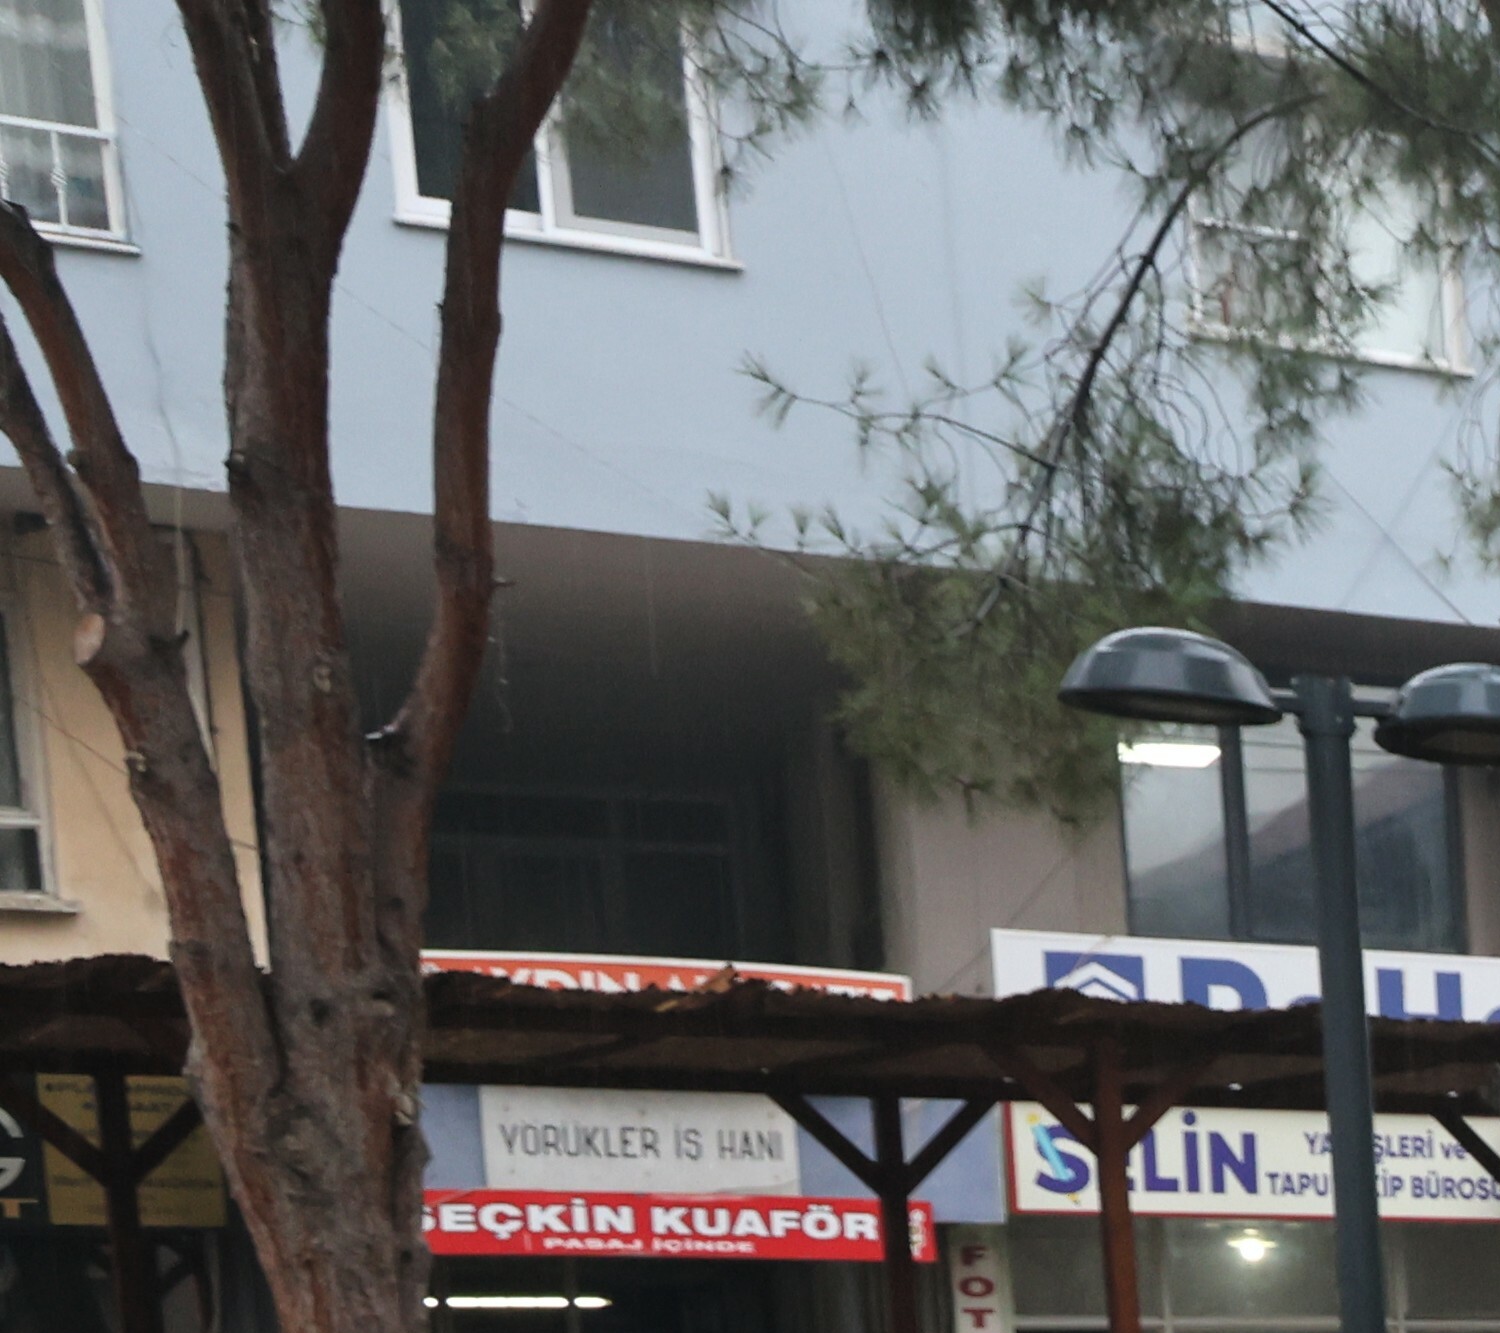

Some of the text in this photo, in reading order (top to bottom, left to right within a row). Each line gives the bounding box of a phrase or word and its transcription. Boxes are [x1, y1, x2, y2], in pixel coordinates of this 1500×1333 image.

[717, 1129, 784, 1161] HANI
[1034, 1111, 1258, 1194] SLİN
[1372, 1129, 1435, 1164] ŞLERİ
[1268, 1172, 1329, 1197] TAPU
[650, 1204, 880, 1241] KUAFÖR
[543, 1237, 644, 1251] PASAJ
